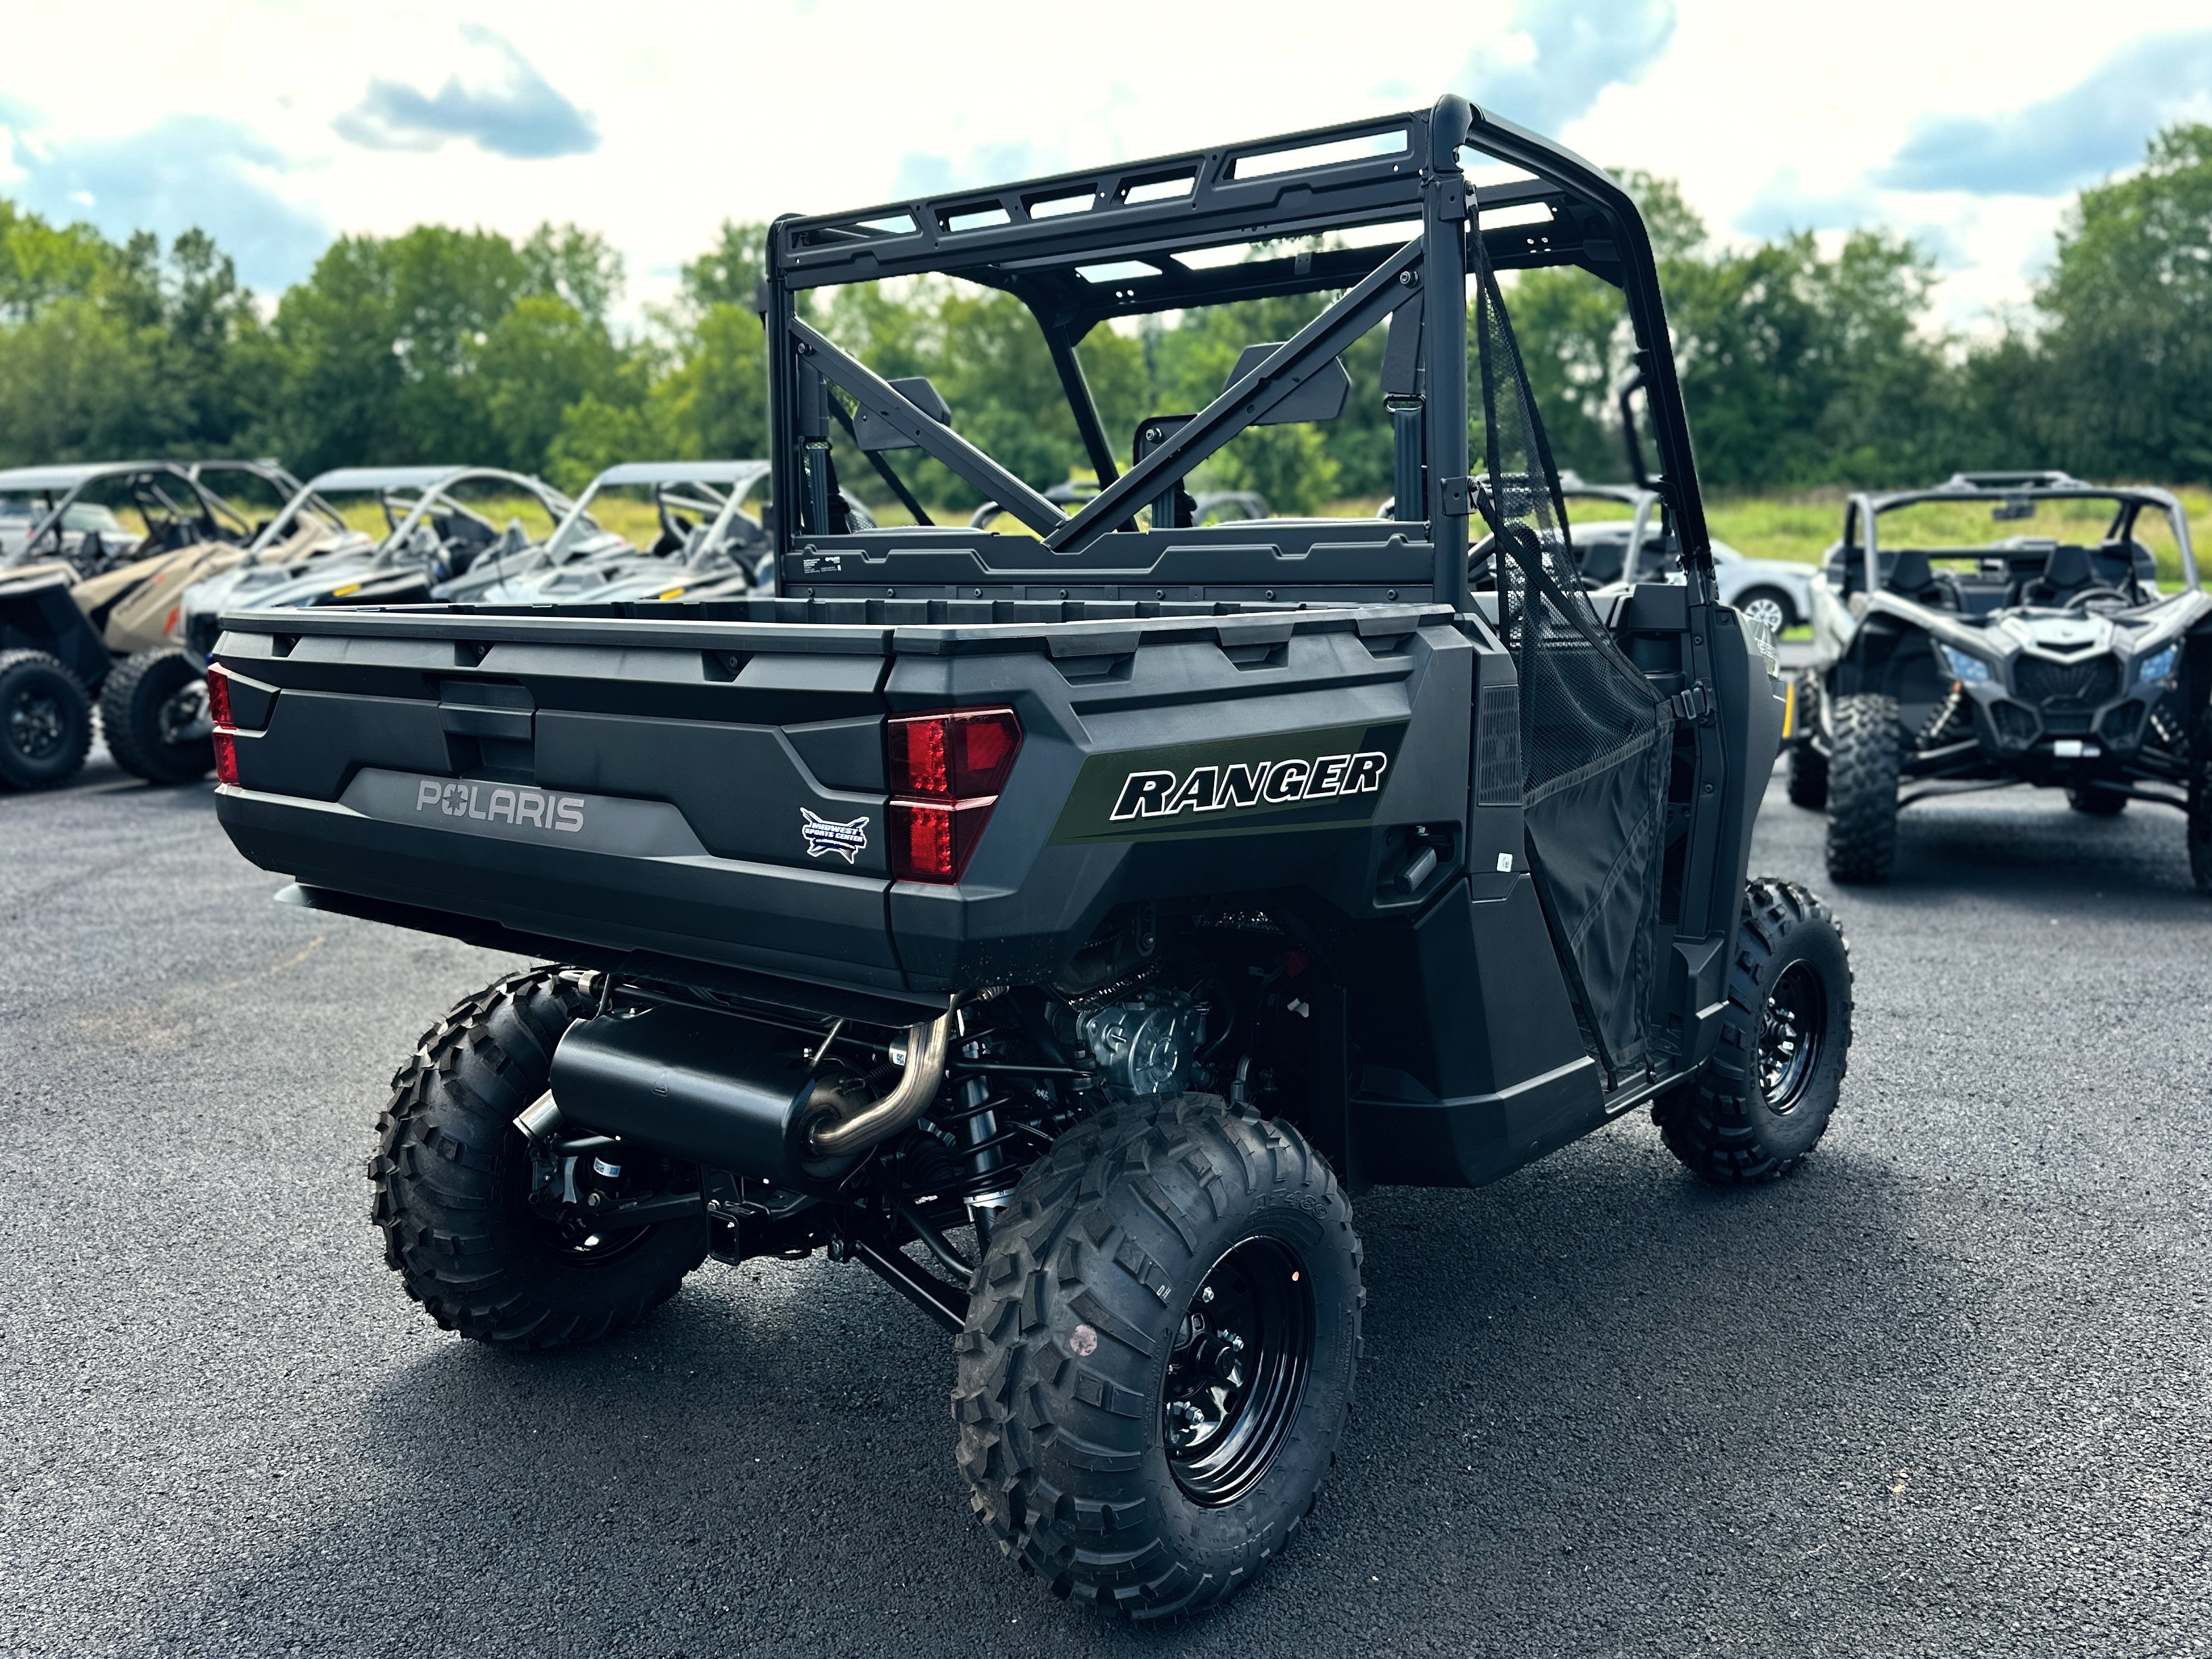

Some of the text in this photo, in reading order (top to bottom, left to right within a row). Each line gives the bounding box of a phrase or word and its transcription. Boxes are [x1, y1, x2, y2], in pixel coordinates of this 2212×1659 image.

[1109, 751, 1388, 821] RANGER
[416, 780, 585, 832] POLARIS
[805, 828, 863, 842] SPORTS CENTER
[811, 822, 859, 835] MIDWEST
